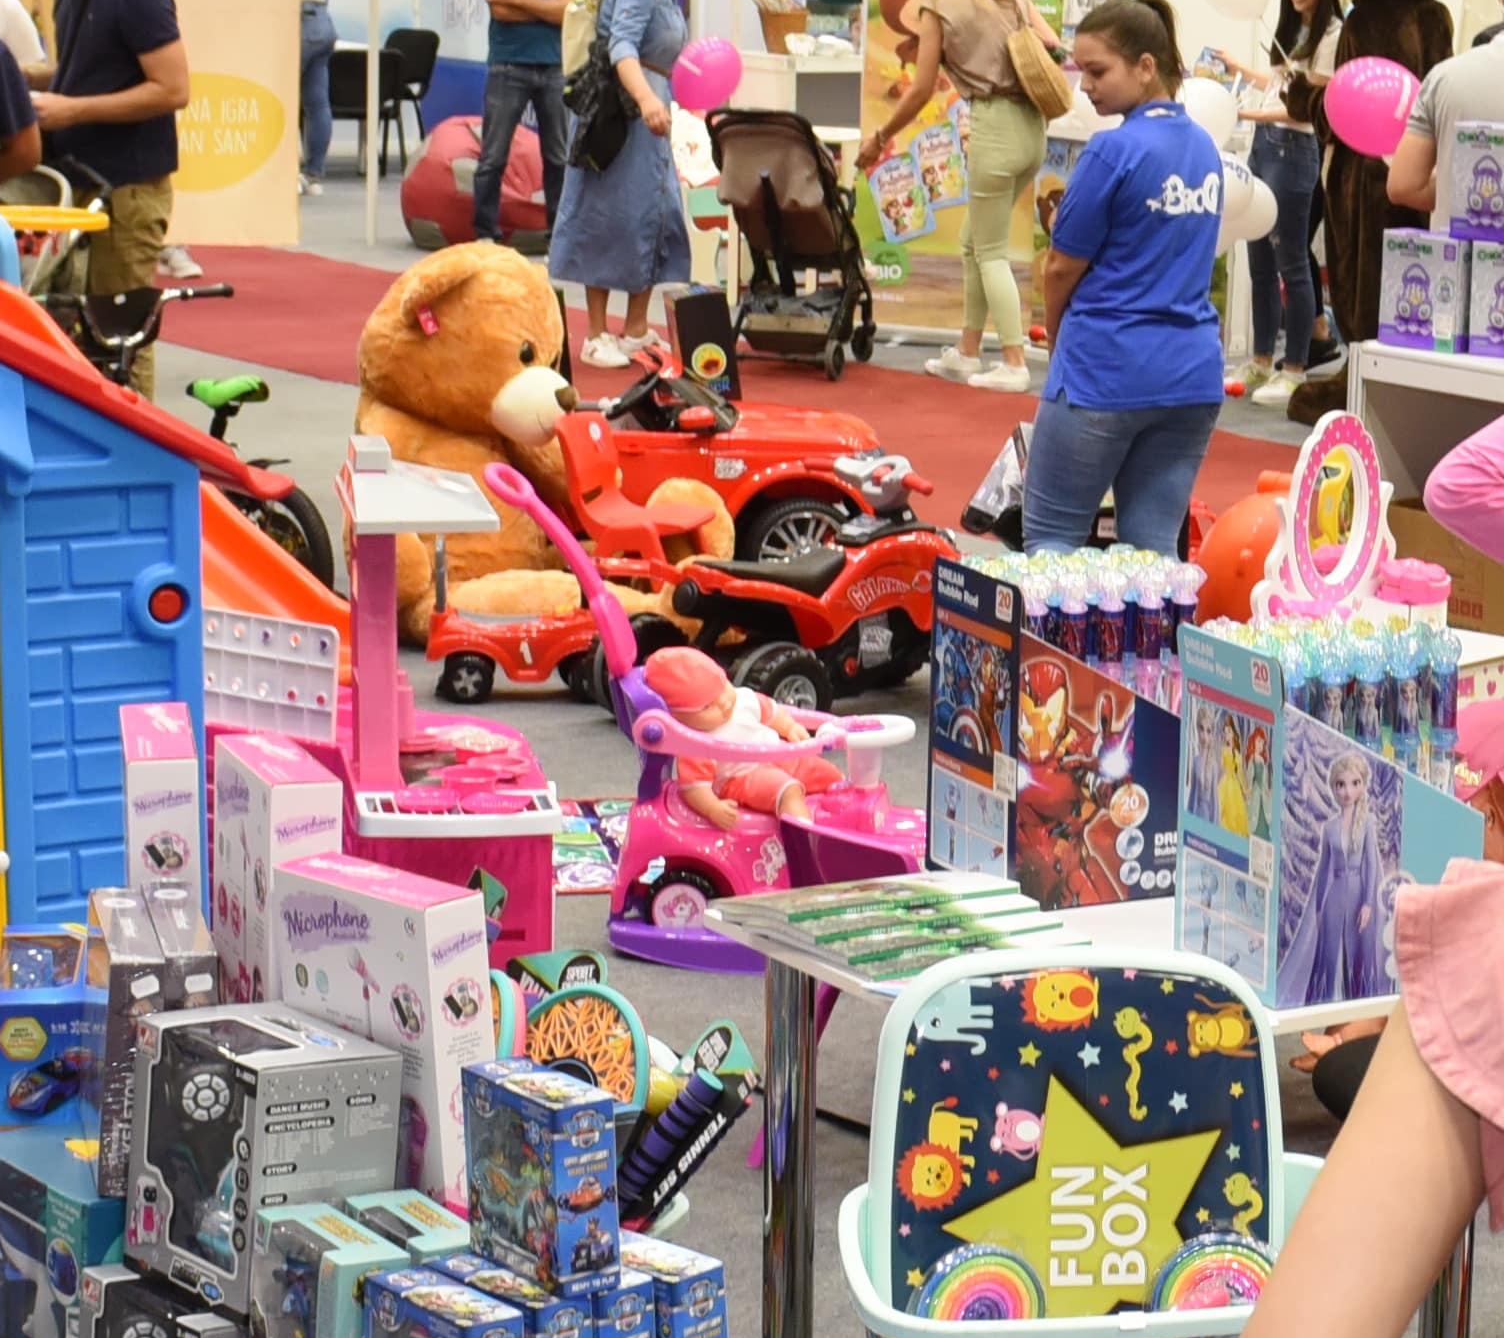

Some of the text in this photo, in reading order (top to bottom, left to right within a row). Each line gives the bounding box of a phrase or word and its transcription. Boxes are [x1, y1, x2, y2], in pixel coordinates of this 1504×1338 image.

[997, 589, 1012, 611] 20
[519, 640, 533, 664] 1
[1252, 661, 1270, 682] 20
[133, 790, 193, 815] Microphone
[275, 815, 338, 841] Microphone
[283, 900, 371, 940] Microphone
[431, 928, 484, 965] Microphone
[268, 1118, 333, 1133] ENCYCLOPEDIA
[653, 1113, 728, 1208] TENNIS SET
[1049, 1165, 1097, 1287] FUN
[1101, 1163, 1151, 1287] BOX
